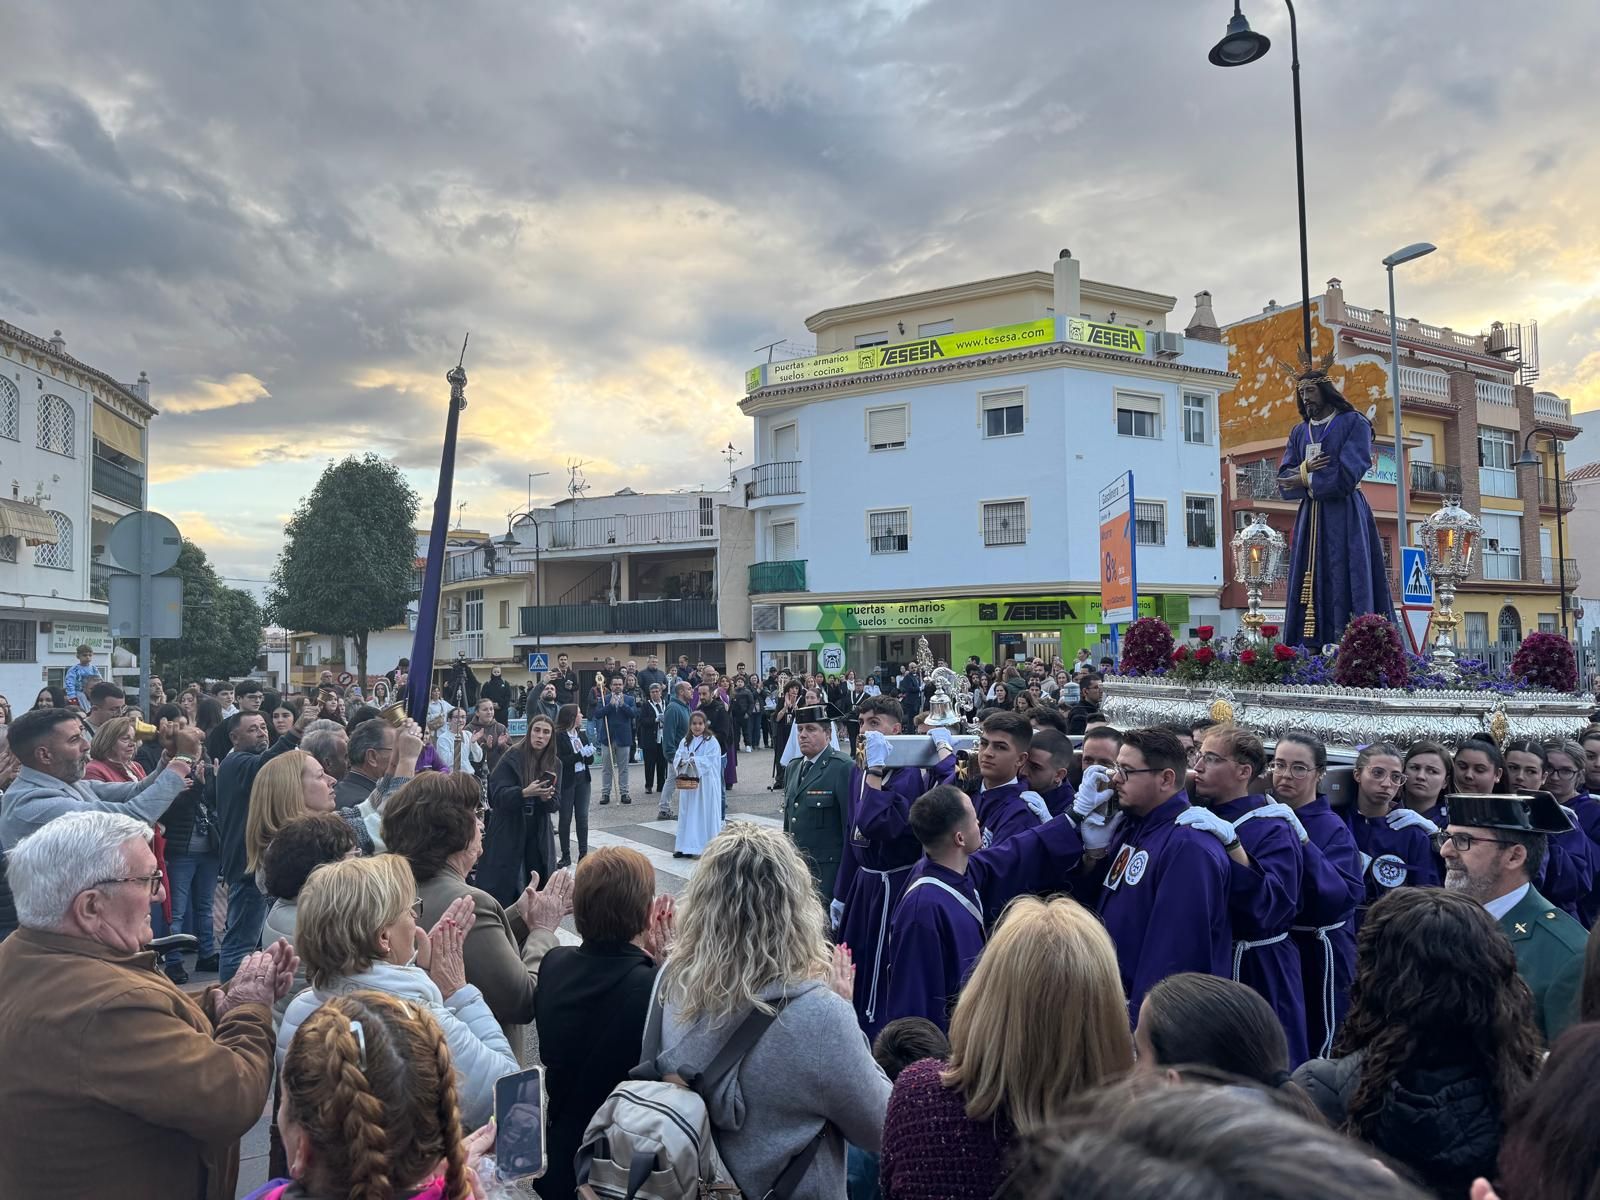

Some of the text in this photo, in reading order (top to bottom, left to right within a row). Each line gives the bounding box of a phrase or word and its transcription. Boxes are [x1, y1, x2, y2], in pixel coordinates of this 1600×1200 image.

[956, 328, 1045, 350] www.tesesa.com
[1087, 323, 1142, 351] TESESA
[879, 339, 945, 367] TESESA
[774, 354, 849, 374] puertas armarios
[780, 366, 844, 382] suelos cocinas
[846, 601, 945, 617] puertas armarios
[1003, 600, 1078, 621] TESESA
[858, 615, 934, 626] suelos cocinas
